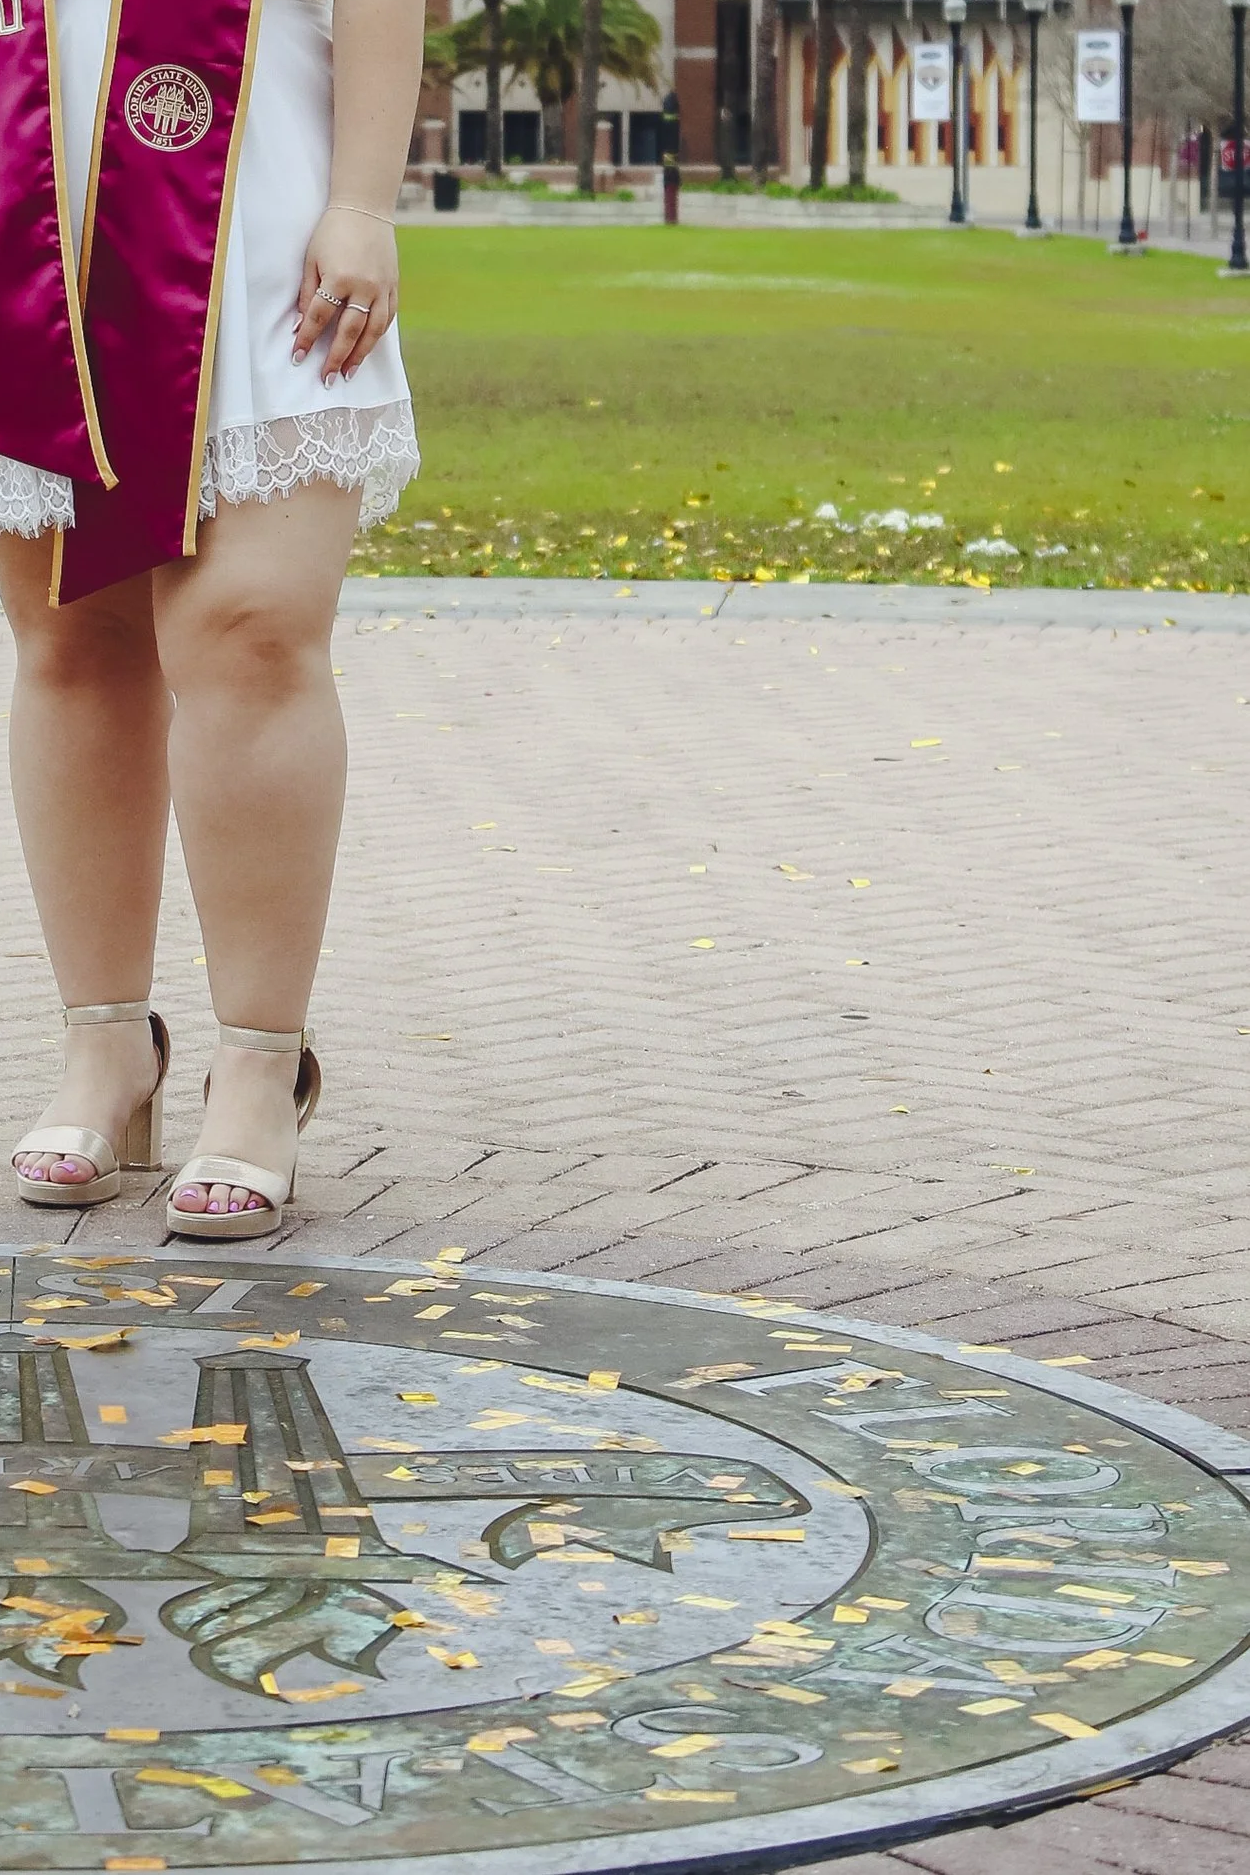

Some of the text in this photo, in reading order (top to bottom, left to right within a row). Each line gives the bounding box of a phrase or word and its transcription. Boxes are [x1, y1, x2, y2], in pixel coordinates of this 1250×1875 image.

[130, 70, 208, 139] FLORIDA STATE UNIVERSITY
[151, 135, 174, 147] 1851
[407, 1463, 713, 1486] VIRES
[718, 1358, 1177, 1698] FLORIDA
